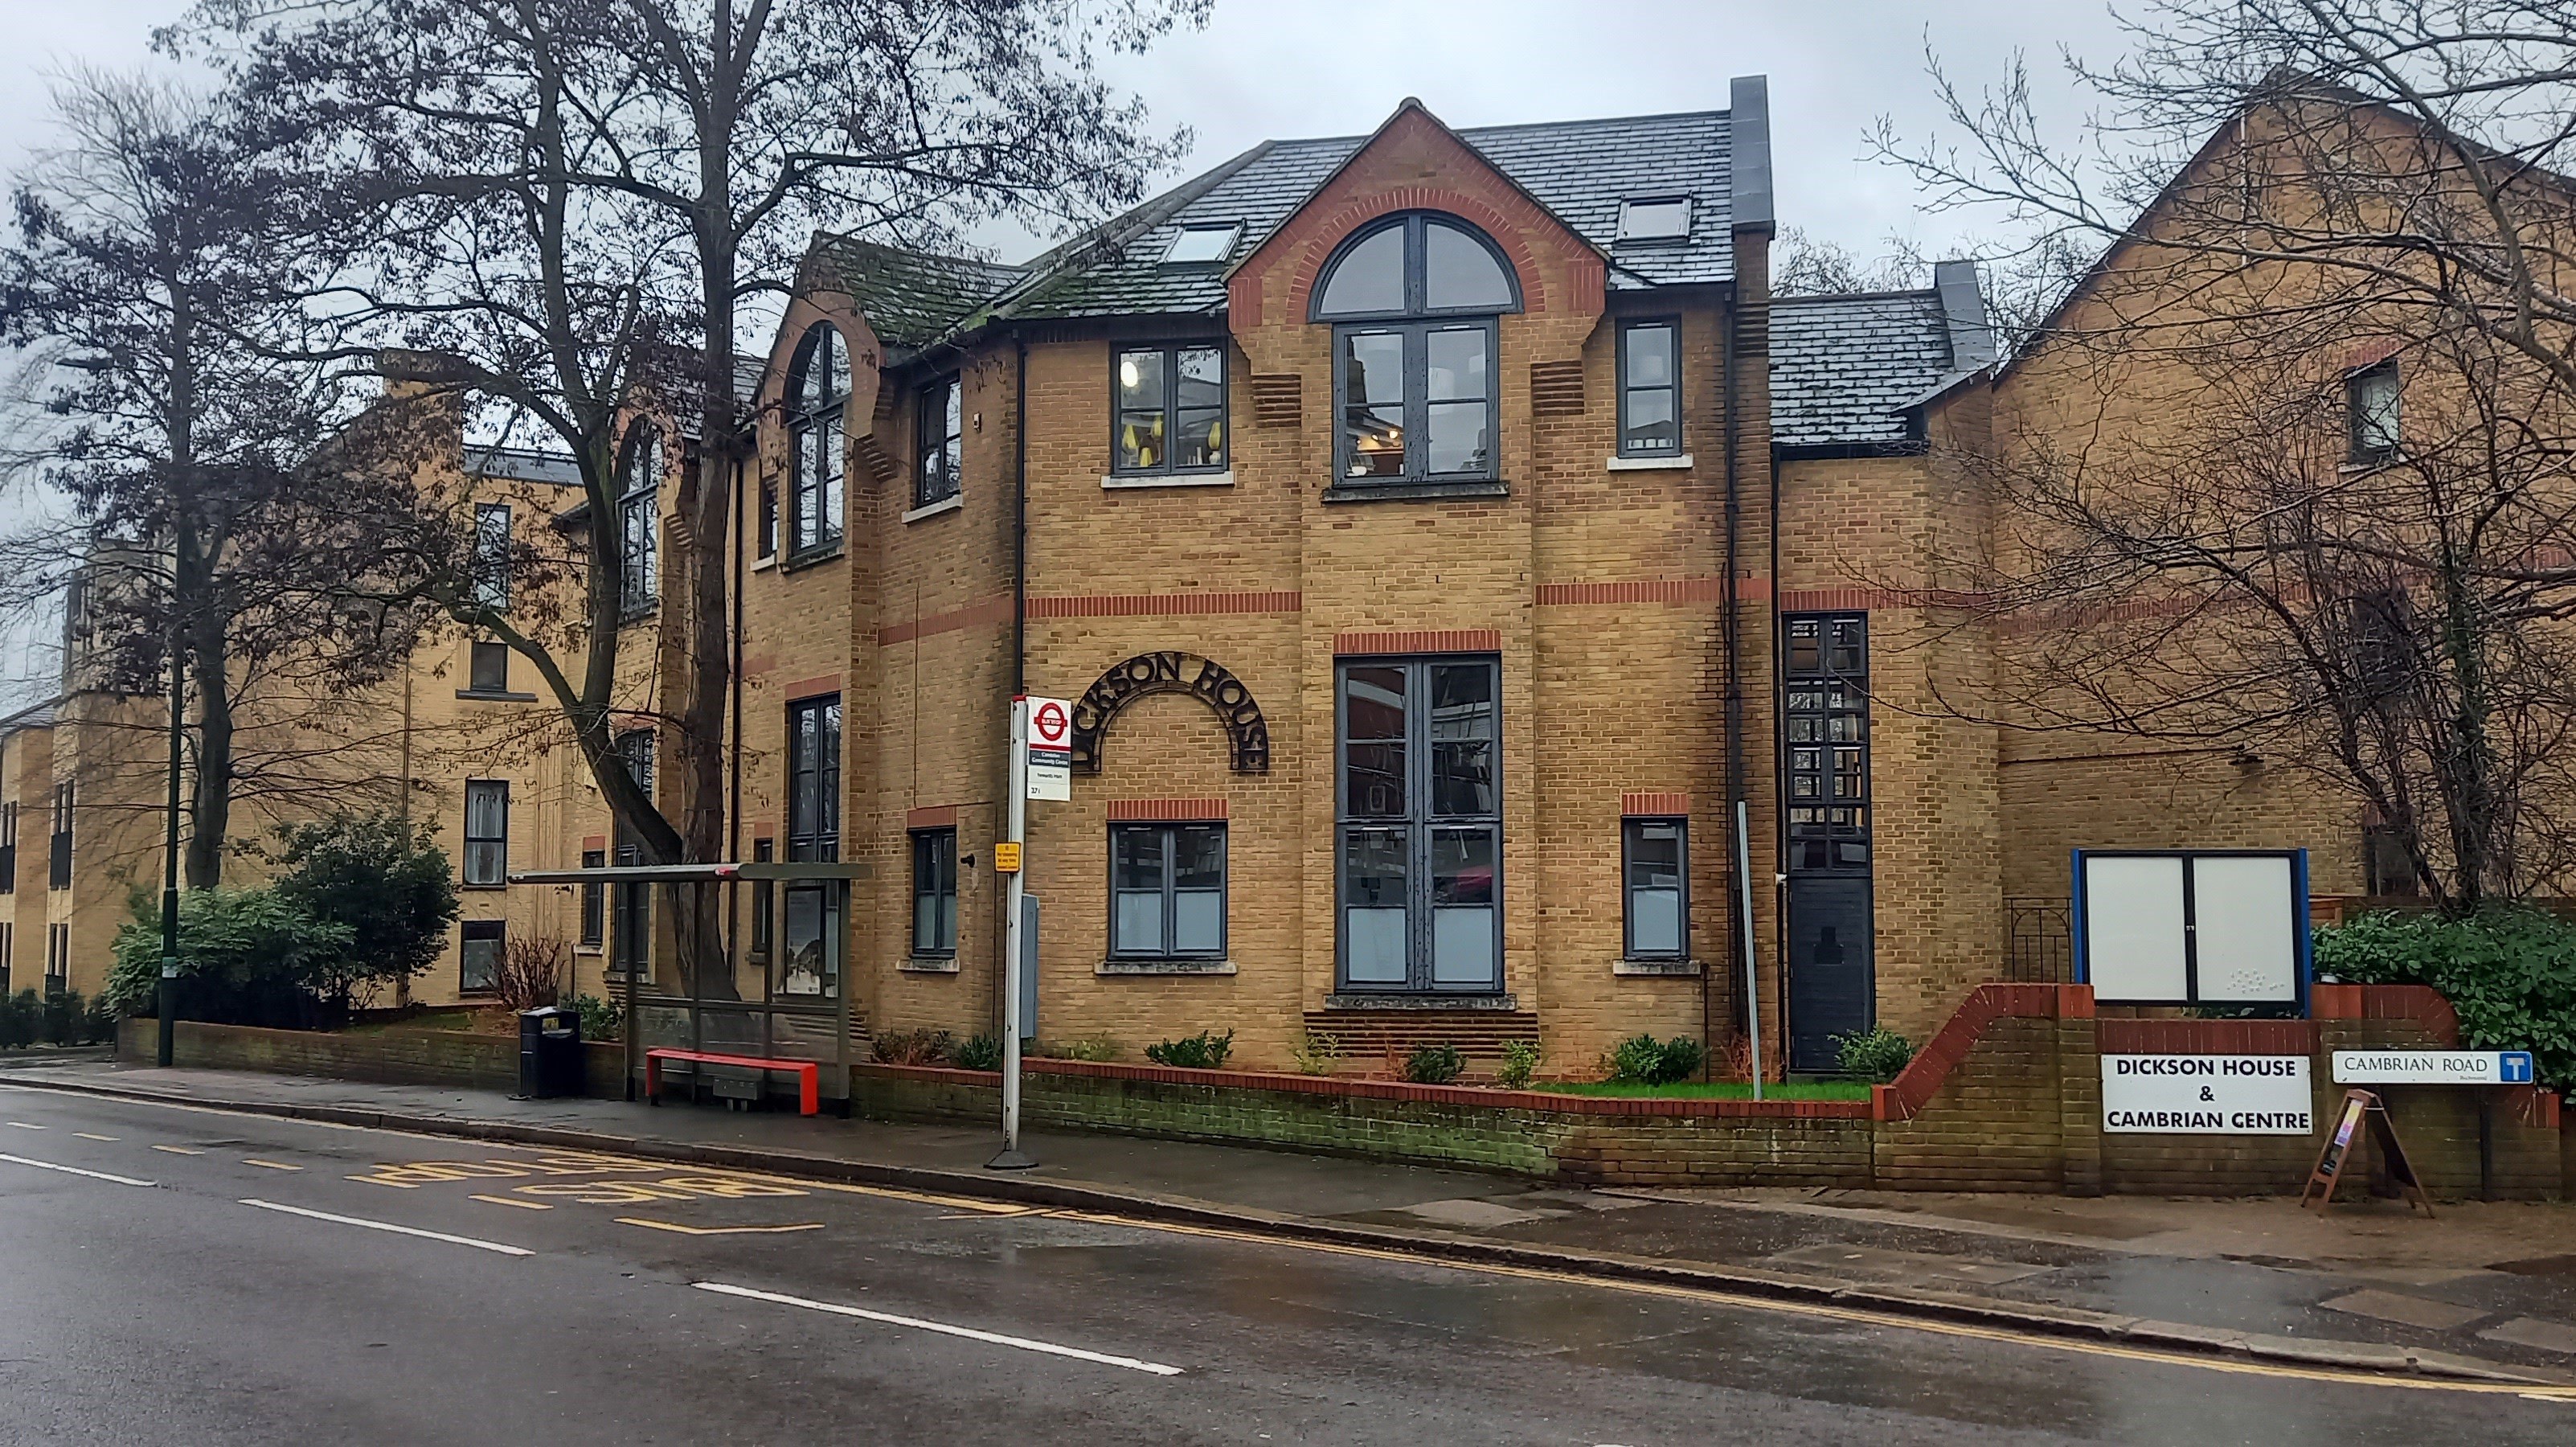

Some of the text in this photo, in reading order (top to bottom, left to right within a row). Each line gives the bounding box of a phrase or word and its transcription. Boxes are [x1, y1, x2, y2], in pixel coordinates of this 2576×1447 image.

[1193, 658, 1268, 769] HOUSE
[2116, 1059, 2296, 1076] DICKSON HOUSE
[2344, 1056, 2488, 1072] CAMBRIAN ROAD
[2199, 1085, 2215, 1102] &
[2107, 1111, 2309, 1129] CAMBRIAN CENTRE
[512, 1177, 810, 1203] BUS
